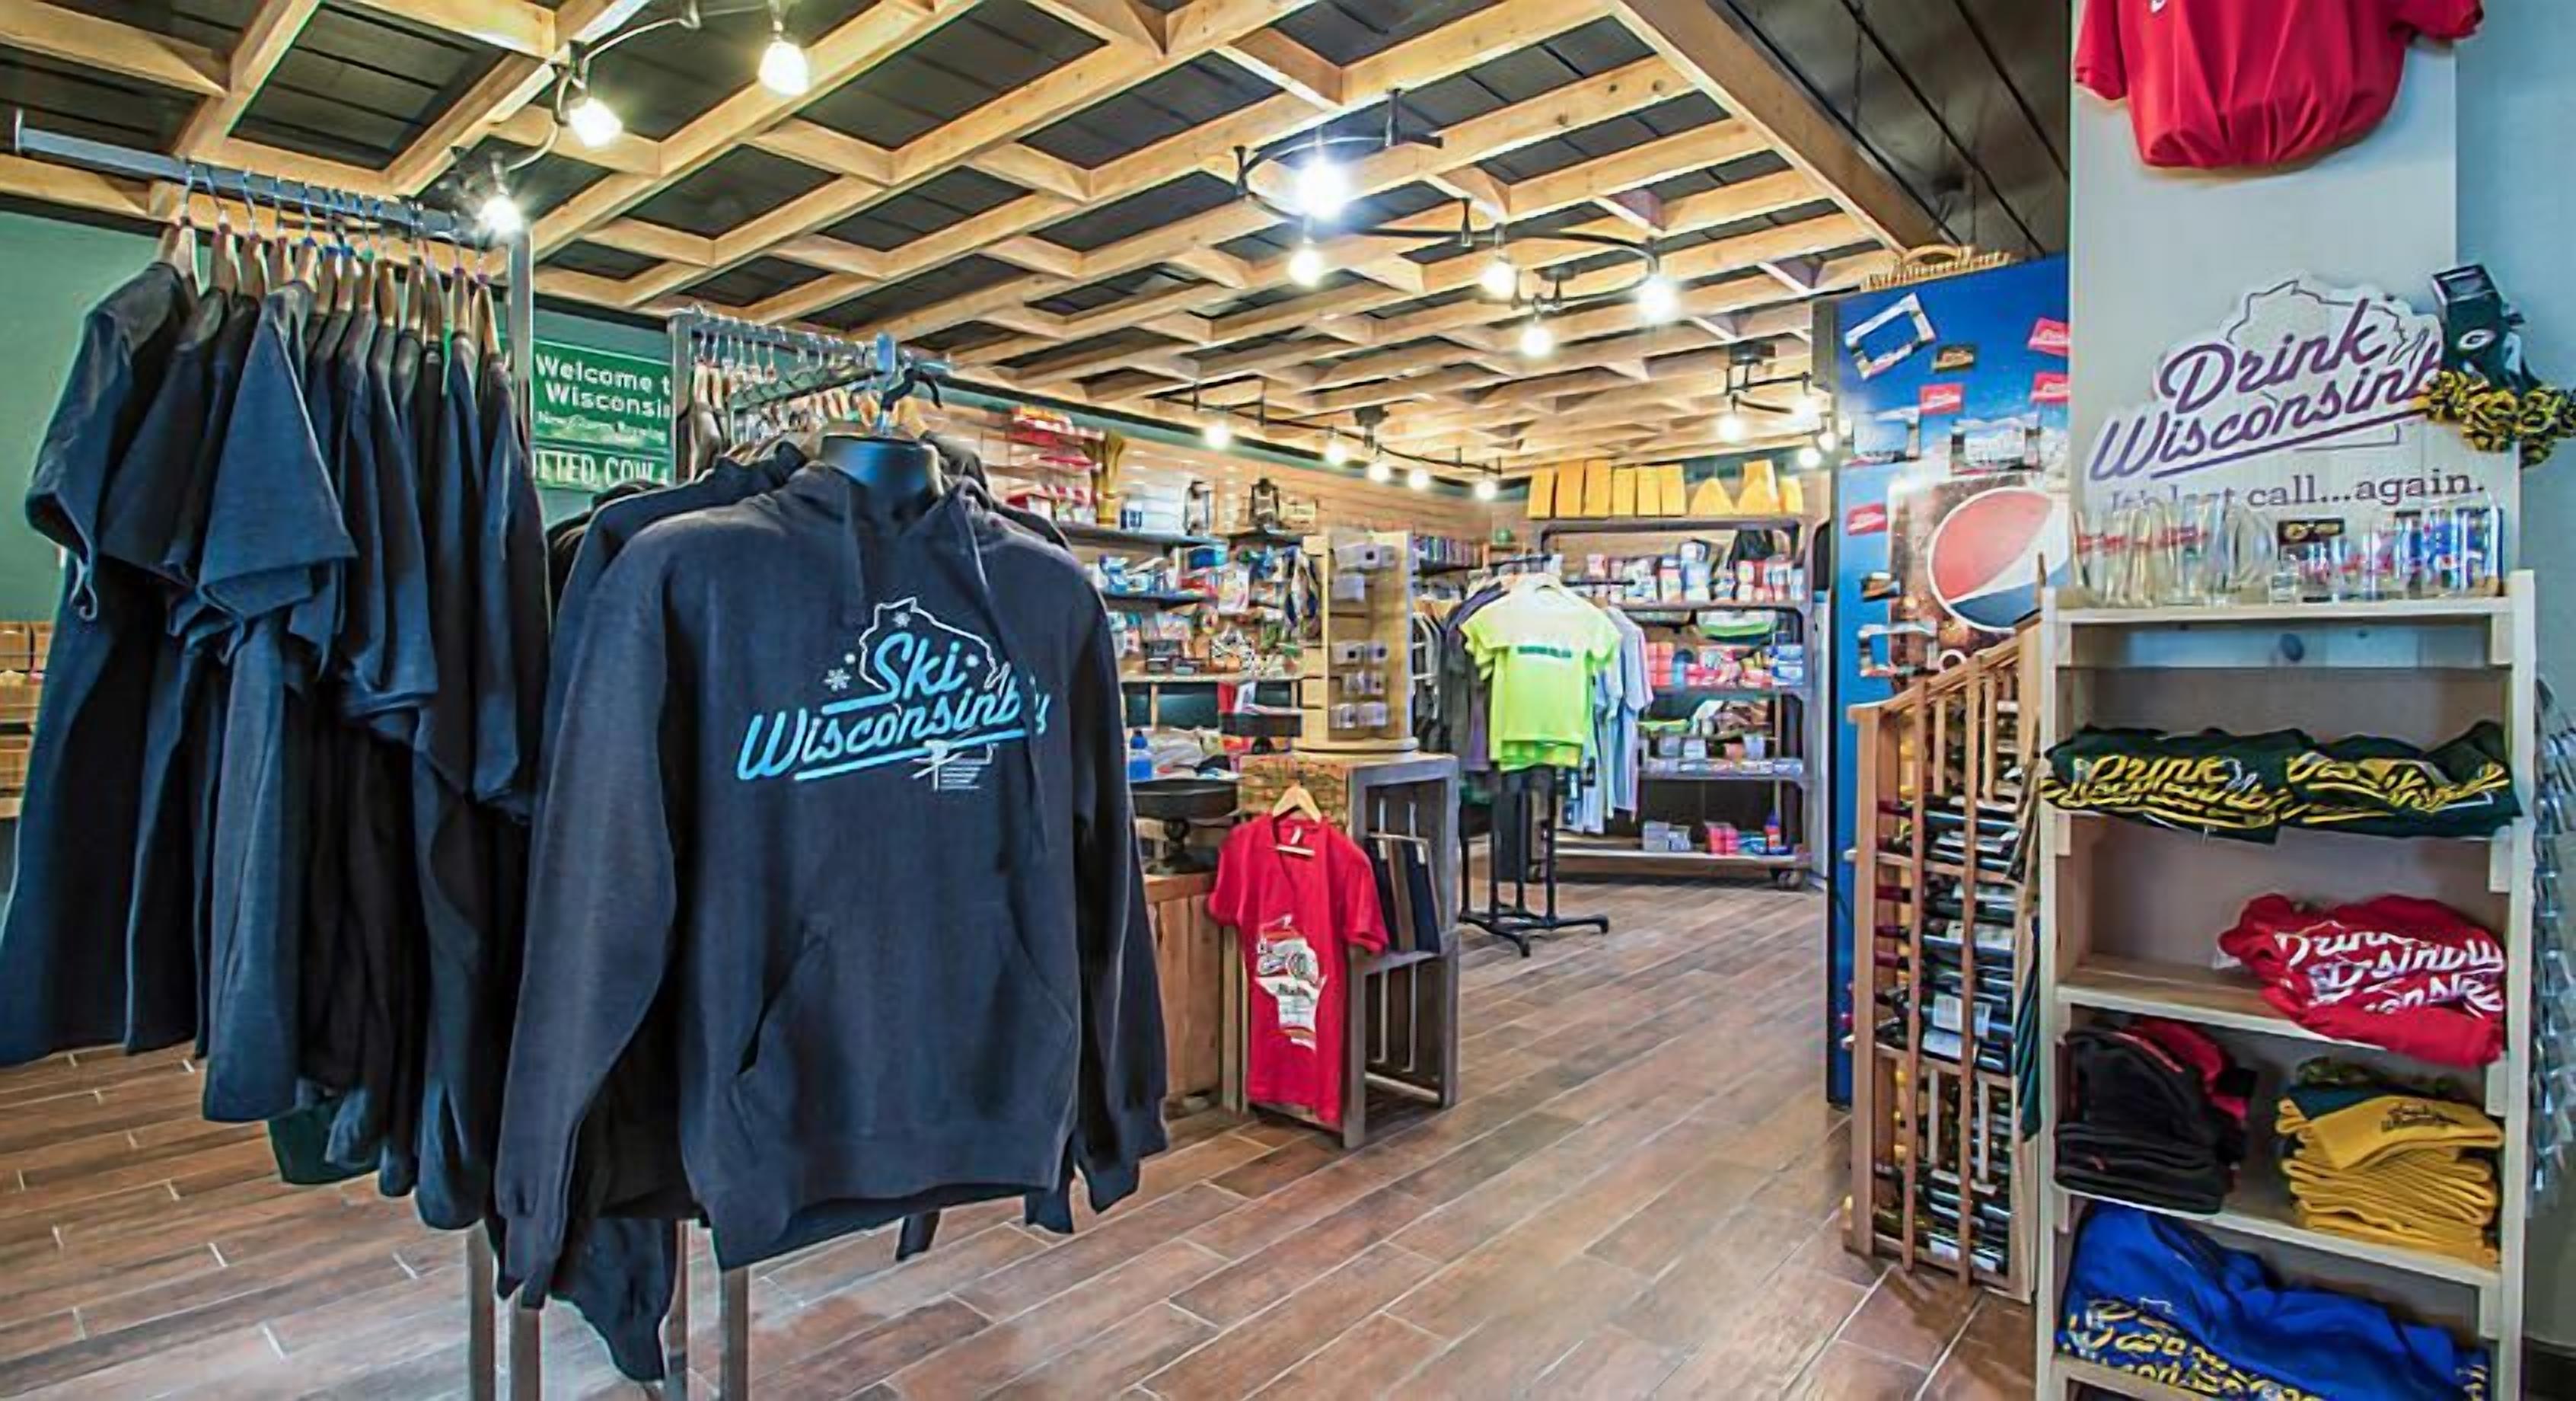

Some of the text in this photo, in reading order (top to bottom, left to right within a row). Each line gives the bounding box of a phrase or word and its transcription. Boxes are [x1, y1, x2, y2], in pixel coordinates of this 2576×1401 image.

[535, 353, 652, 393] Welcome
[2160, 298, 2386, 413] Drink
[822, 631, 968, 716] Ski
[736, 676, 1051, 780] Wisconsinby
